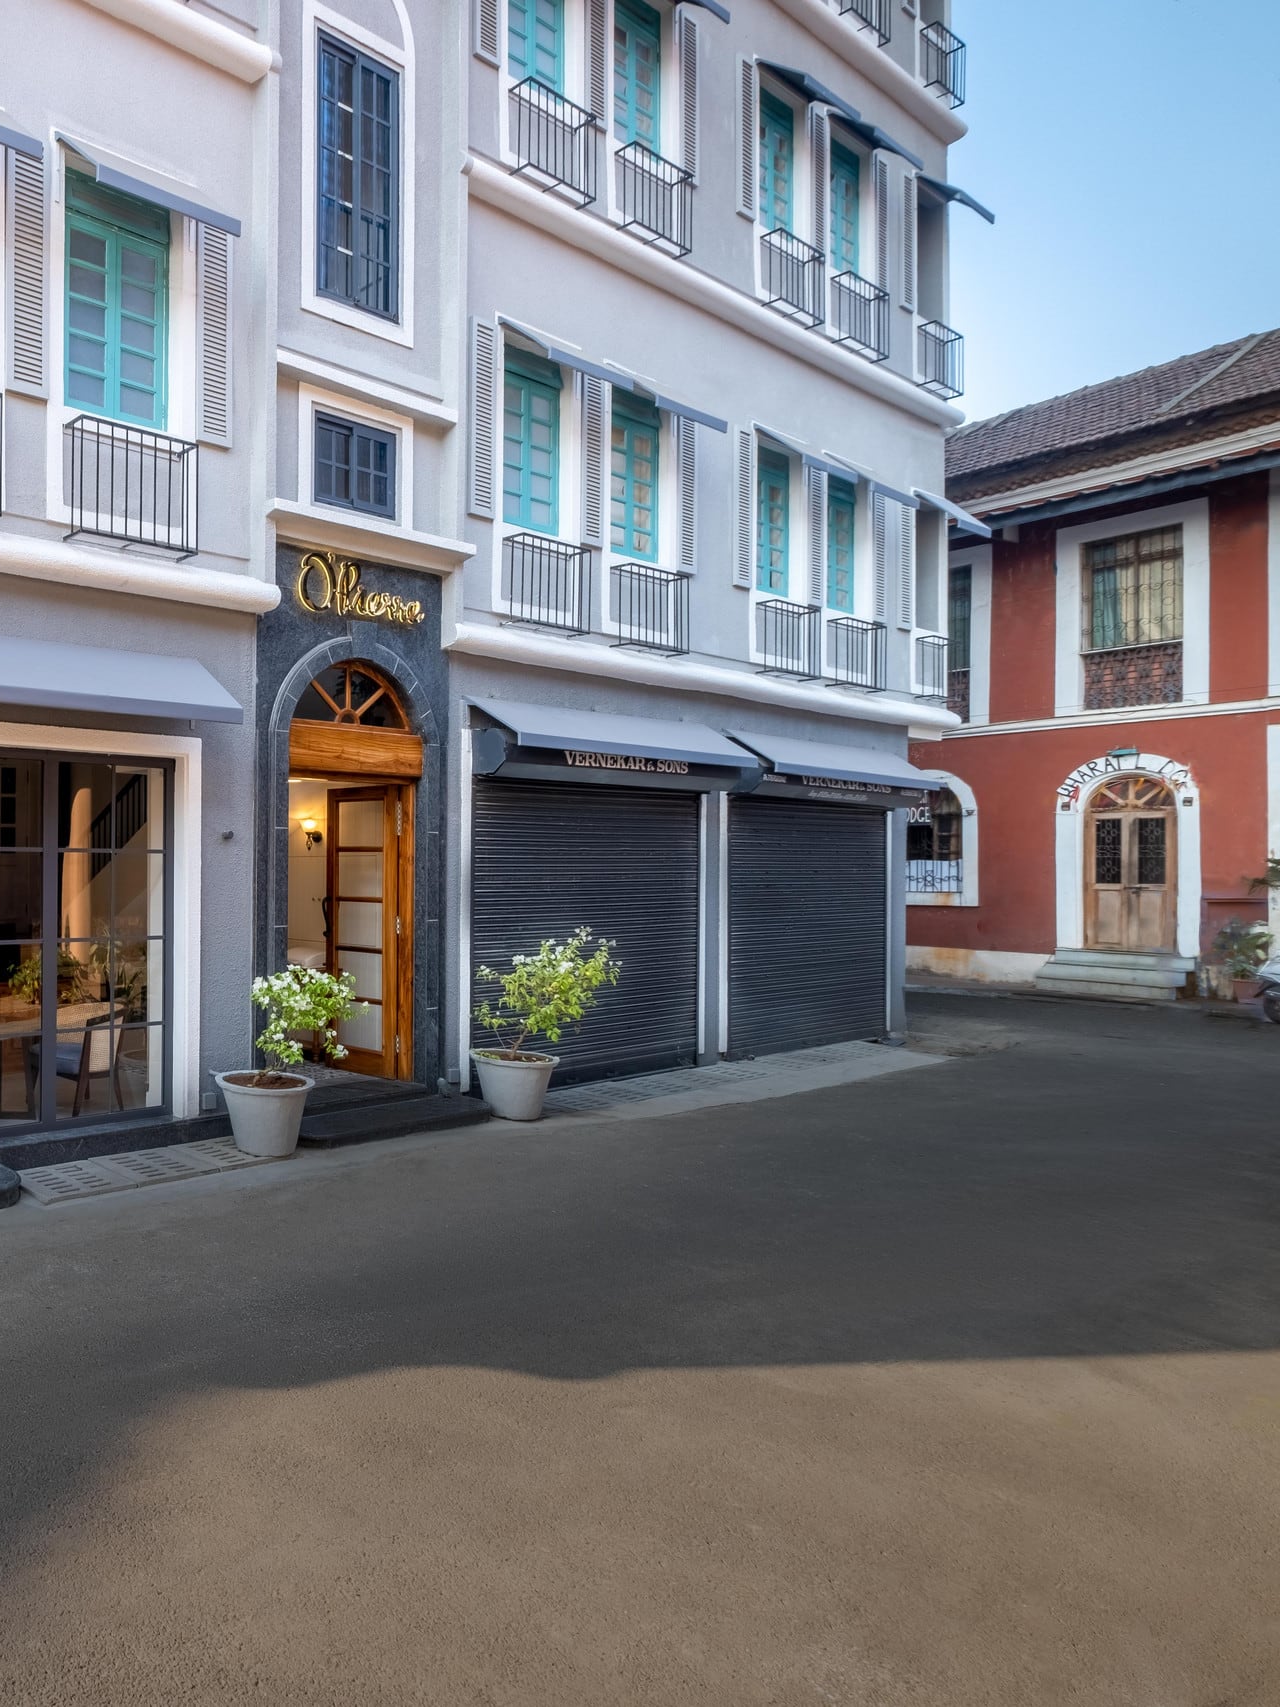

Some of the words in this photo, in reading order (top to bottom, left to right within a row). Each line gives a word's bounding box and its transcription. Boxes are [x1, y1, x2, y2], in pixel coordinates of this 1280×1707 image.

[564, 750, 645, 771] VERNEKAR
[647, 761, 655, 772] &
[656, 759, 688, 774] SONS
[802, 775, 860, 790] VERNEKAR
